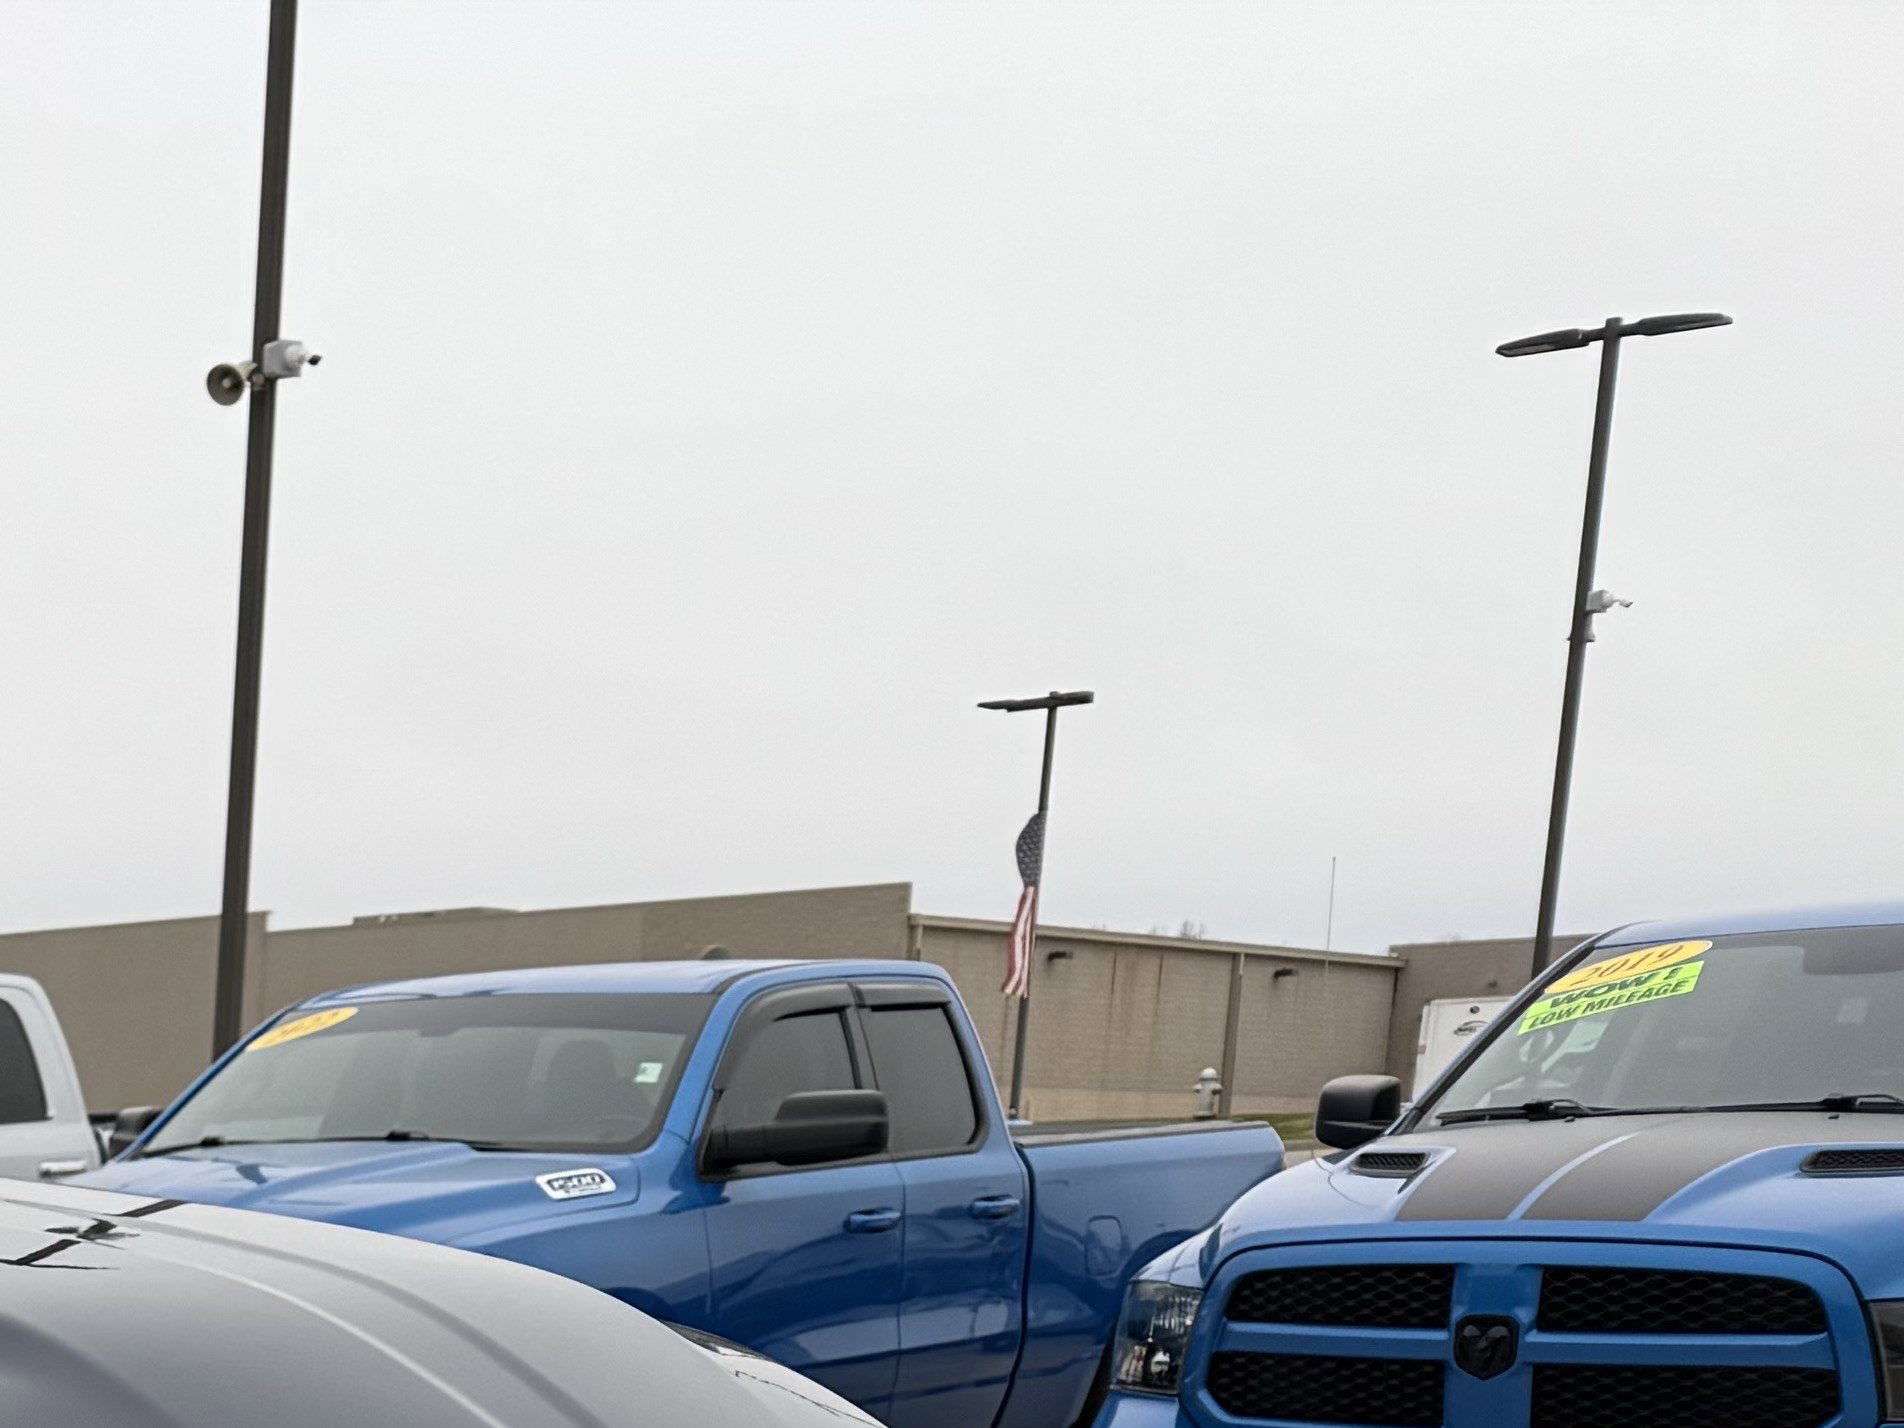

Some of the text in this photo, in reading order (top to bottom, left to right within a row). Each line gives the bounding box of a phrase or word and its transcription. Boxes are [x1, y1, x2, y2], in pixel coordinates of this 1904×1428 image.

[1570, 944, 1683, 987] 2019
[1528, 979, 1691, 1030] LOW MILEAGE
